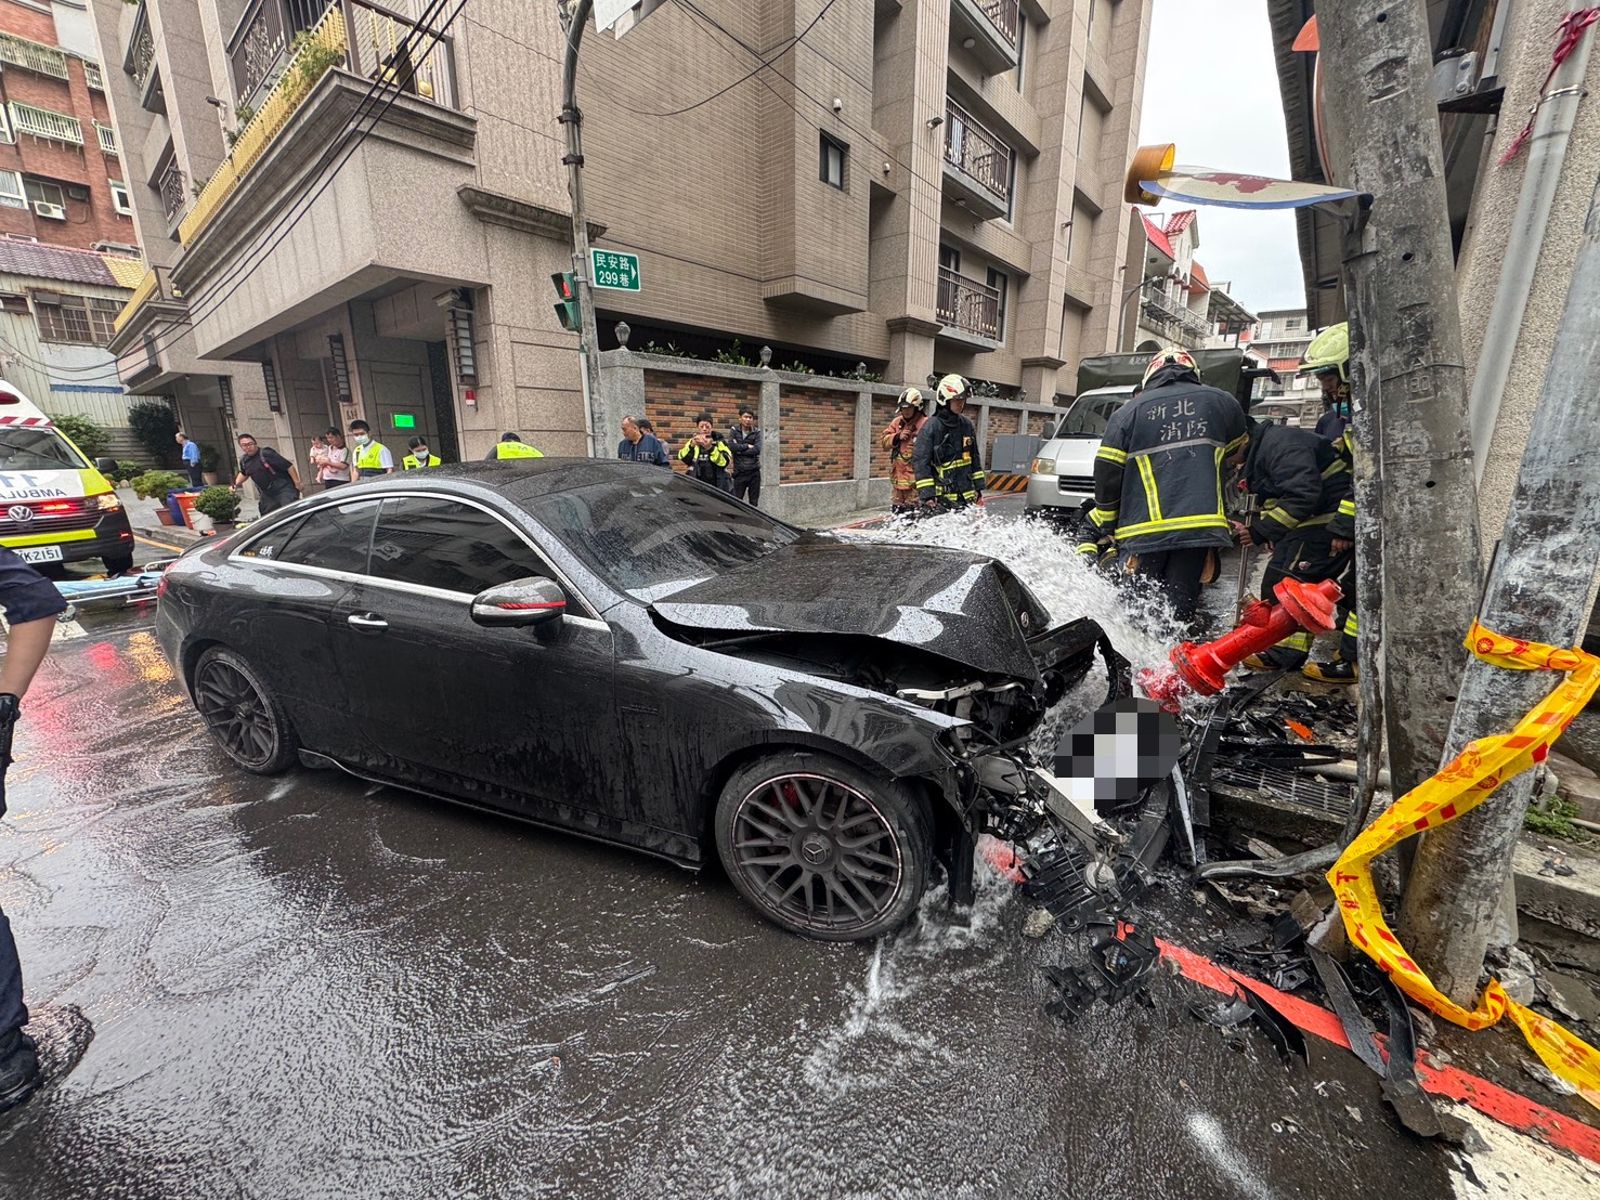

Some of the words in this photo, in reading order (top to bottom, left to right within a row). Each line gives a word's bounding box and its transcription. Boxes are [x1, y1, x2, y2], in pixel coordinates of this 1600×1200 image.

[596, 253, 629, 270] 民安路
[599, 270, 629, 287] 299巷
[1146, 399, 1195, 420] 新北
[1160, 418, 1208, 441] 消防
